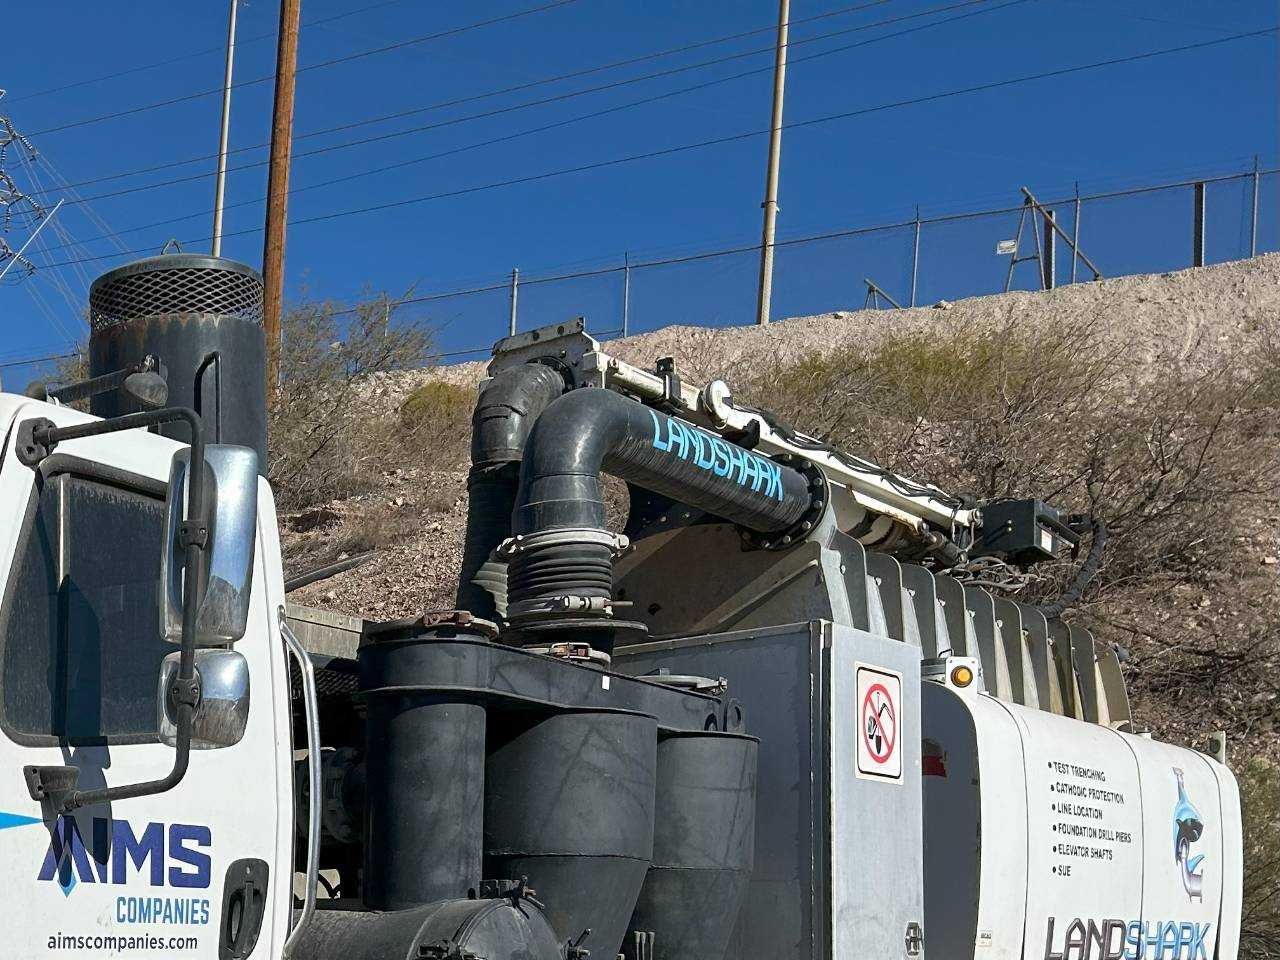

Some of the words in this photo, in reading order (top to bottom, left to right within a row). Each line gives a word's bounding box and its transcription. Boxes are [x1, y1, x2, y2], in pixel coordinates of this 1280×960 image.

[649, 409, 783, 501] LANDSHARK
[1053, 762, 1070, 775] TEST
[1071, 765, 1106, 782] TRENCHING
[1055, 782, 1087, 798] CATHODIC
[1088, 788, 1125, 804] PROTECTION
[1057, 802, 1072, 815] LINE
[1073, 805, 1103, 820] LOCATION
[1058, 823, 1097, 838] FOUNDATION
[1098, 829, 1114, 841] DRILL
[1115, 831, 1132, 843] PIERS
[37, 814, 211, 889] AIMS
[1058, 844, 1089, 858] ELEVATOR
[1091, 848, 1113, 860] SHAFTS
[1058, 865, 1071, 876] SUE
[117, 896, 210, 924] COMPANIES
[47, 931, 198, 952] aimscompanies.com
[1044, 916, 1210, 960] LANDSHARK
